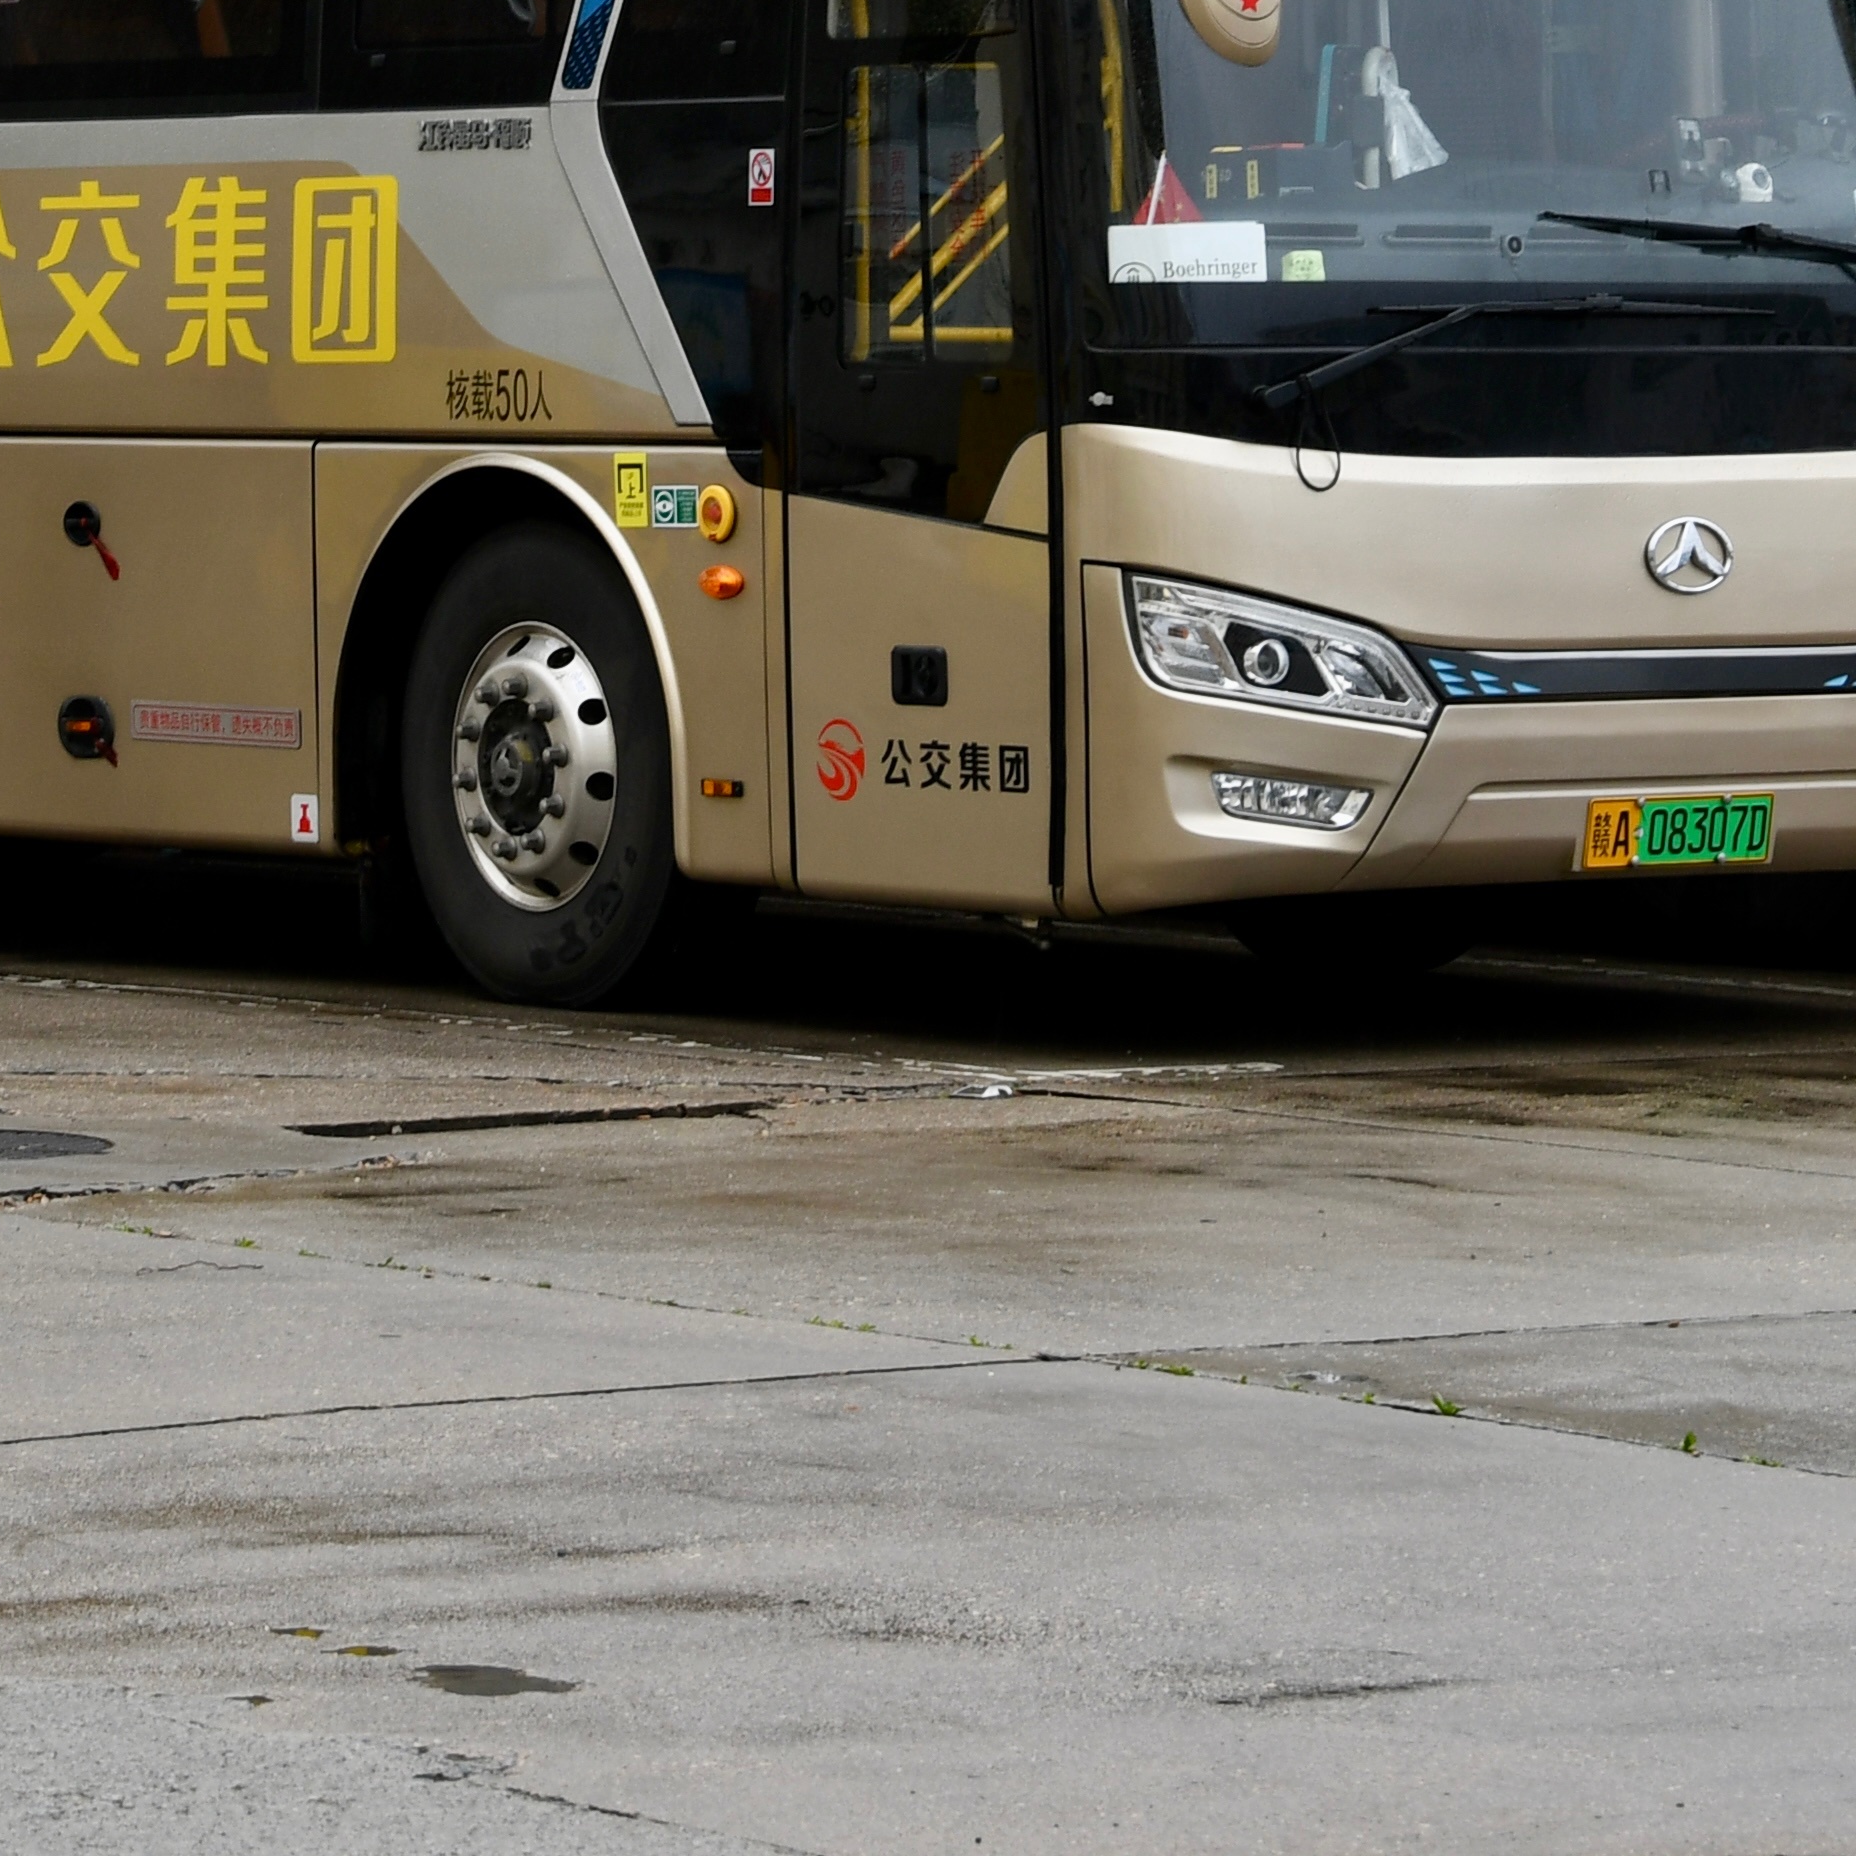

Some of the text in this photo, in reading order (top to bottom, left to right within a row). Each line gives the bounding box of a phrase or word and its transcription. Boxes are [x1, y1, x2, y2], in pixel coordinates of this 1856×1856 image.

[1162, 257, 1258, 278] Boehringer
[445, 368, 553, 422] 核载50人
[881, 739, 1030, 794] 公交集团
